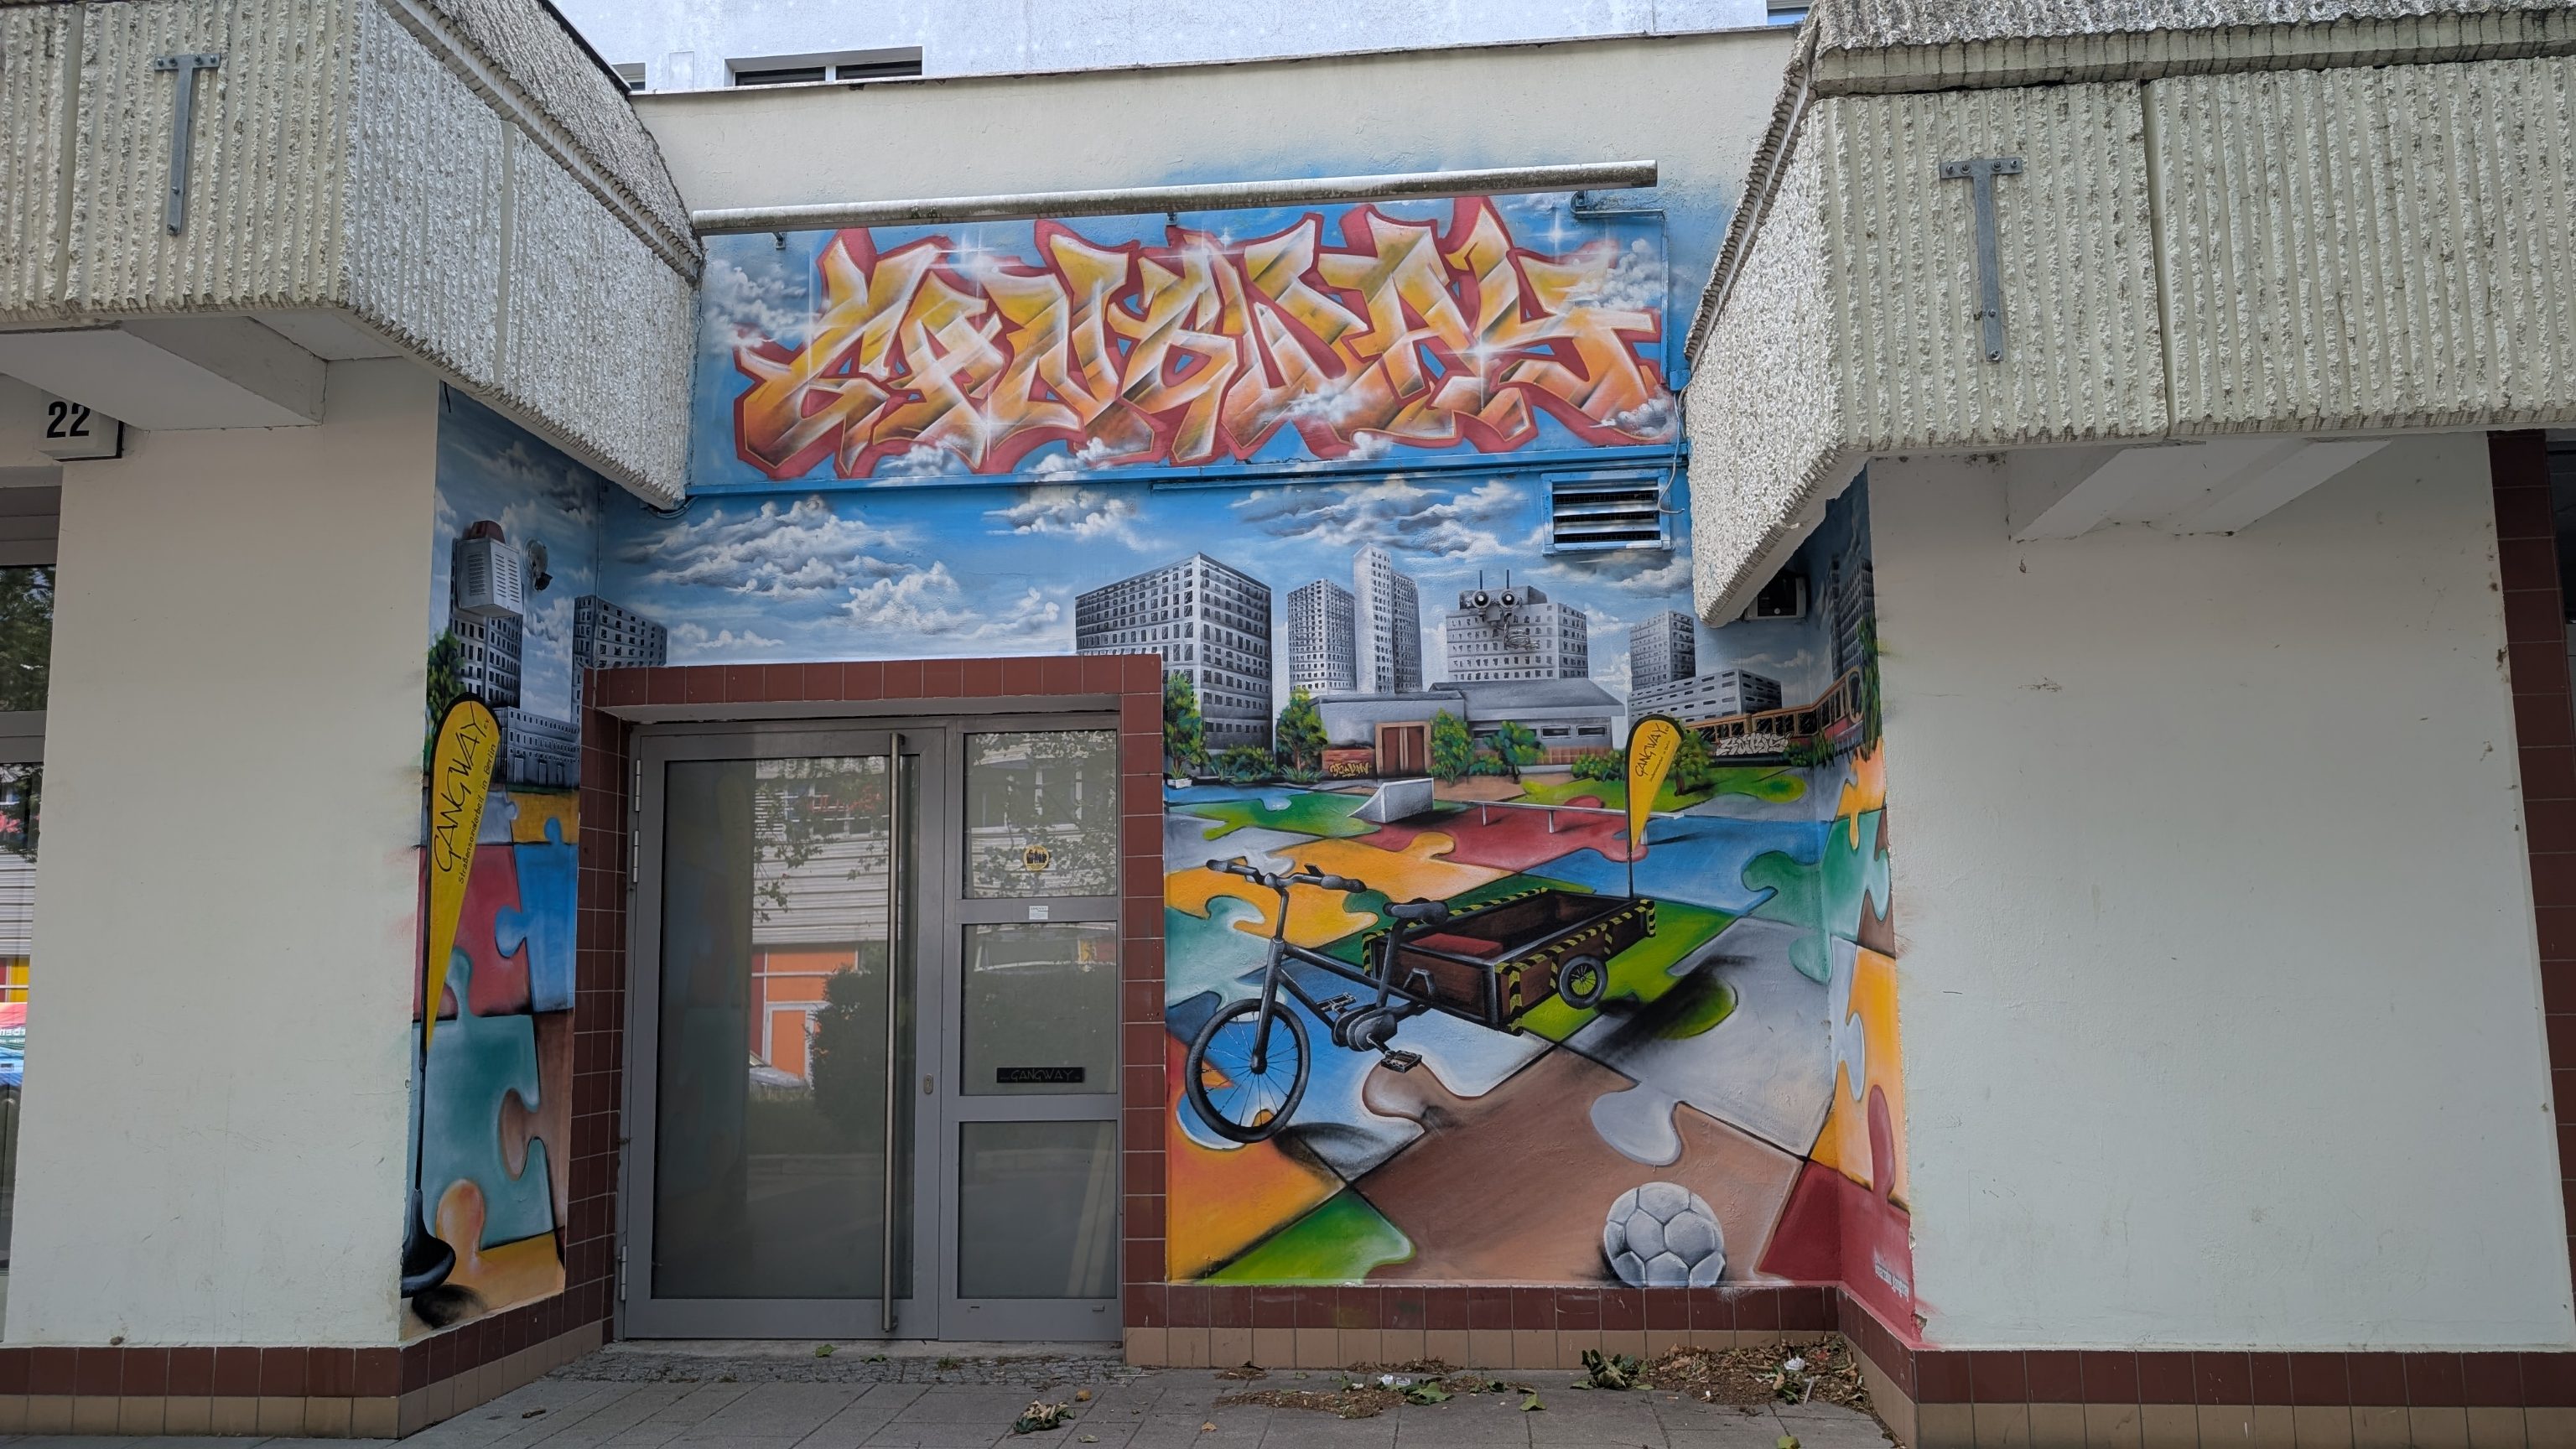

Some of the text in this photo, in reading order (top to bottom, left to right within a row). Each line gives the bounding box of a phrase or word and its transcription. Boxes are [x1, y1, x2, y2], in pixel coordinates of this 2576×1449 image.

[47, 401, 91, 438] 22
[484, 744, 496, 776] Berlin
[1635, 723, 1668, 777] GANGWAY
[434, 701, 487, 872] GANGWAY
[1010, 1068, 1073, 1082] GANGWAY
